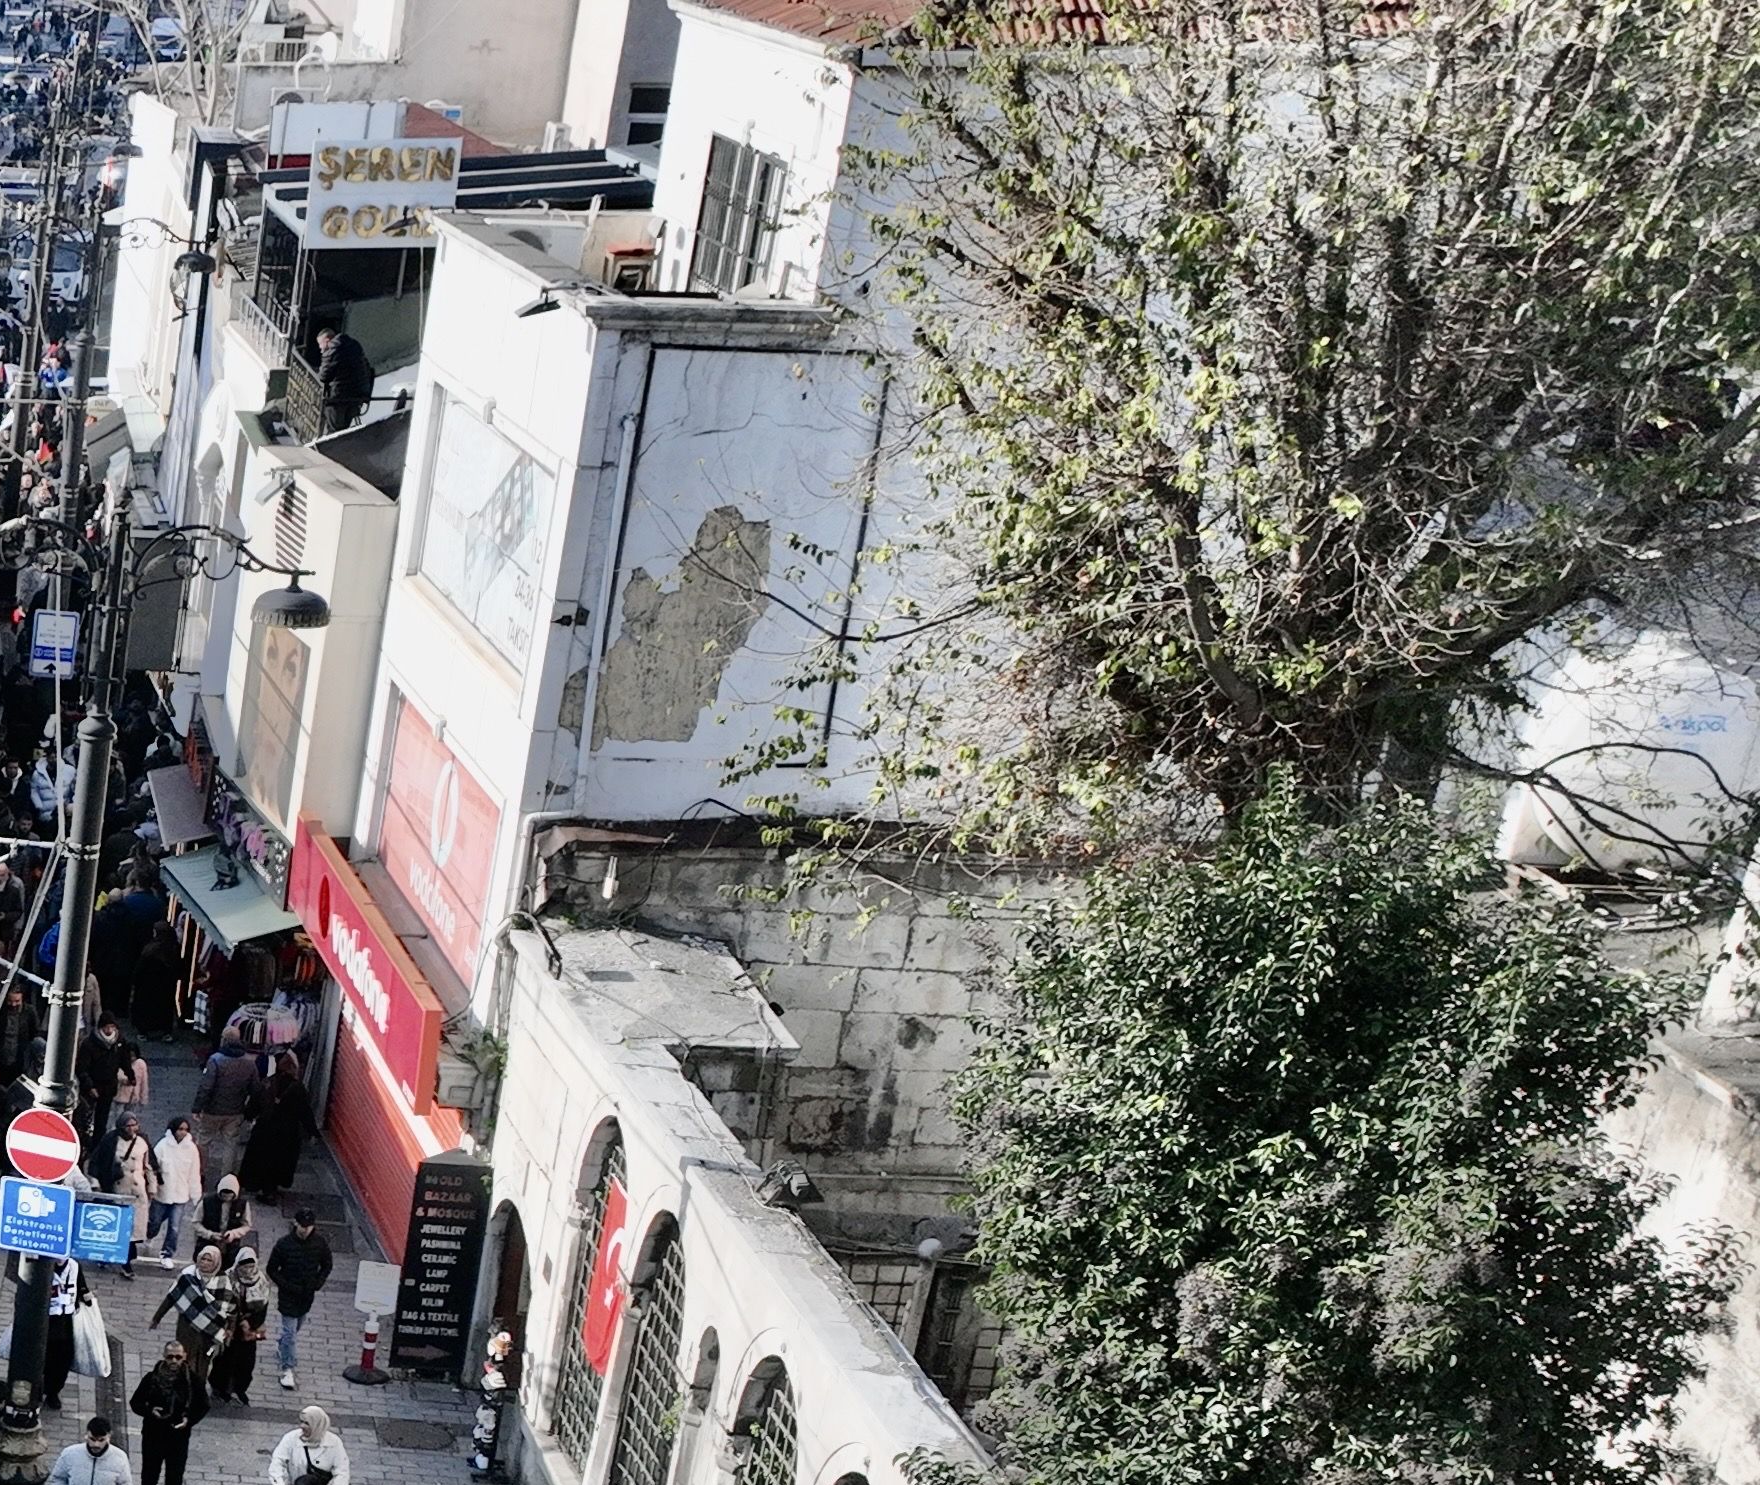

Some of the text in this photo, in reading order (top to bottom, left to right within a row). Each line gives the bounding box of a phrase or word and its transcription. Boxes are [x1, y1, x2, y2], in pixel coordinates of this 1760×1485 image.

[318, 146, 456, 191] ŞEREN
[409, 857, 456, 944] vodafone
[330, 912, 391, 1035] vodafone
[424, 1190, 472, 1203] BAZAAR
[427, 1208, 476, 1220] MOSQUE
[5, 1215, 64, 1233] Elektronik
[420, 1224, 467, 1236] JEWELLERY
[3, 1225, 65, 1243] Denetleme
[11, 1236, 55, 1251] Sistemi
[425, 1268, 448, 1279] LAMP
[419, 1283, 451, 1294] CARPET
[402, 1310, 418, 1321] BAG
